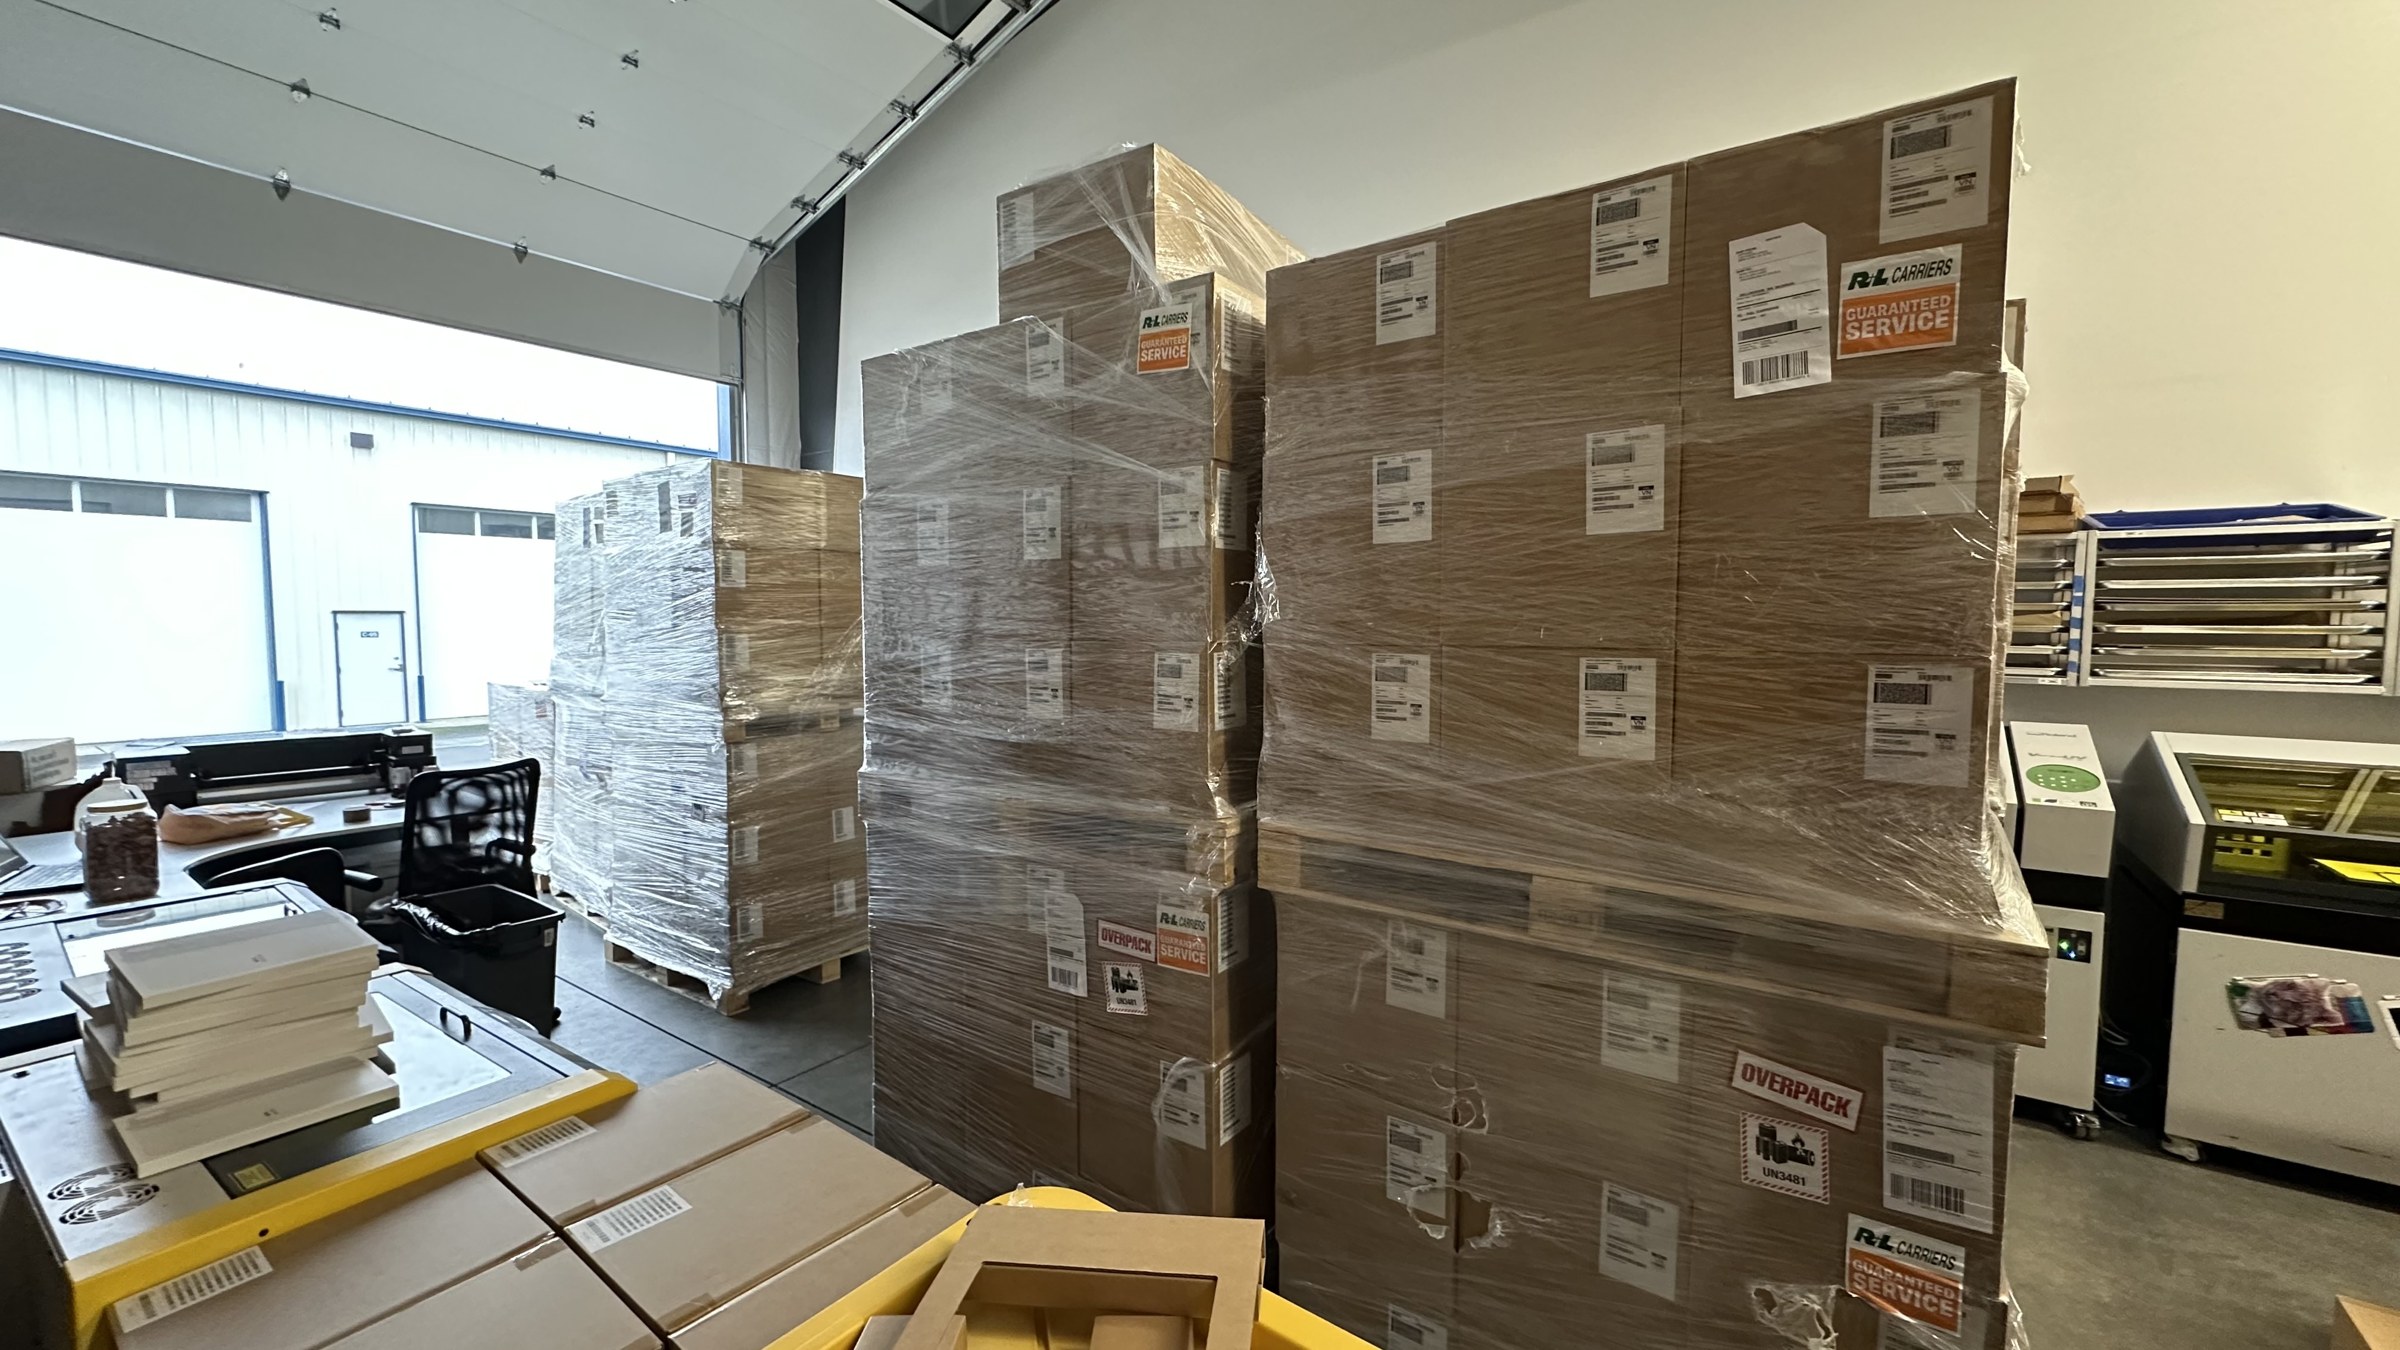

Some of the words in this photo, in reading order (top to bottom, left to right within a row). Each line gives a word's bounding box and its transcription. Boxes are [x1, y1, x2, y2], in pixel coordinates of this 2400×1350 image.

[1848, 268, 1888, 291] R+L
[1891, 258, 1954, 284] CARRIERS
[1161, 311, 1189, 326] CARRIERS
[1846, 294, 1951, 322] GUARANTEED
[1845, 309, 1950, 341] SERVICE
[1140, 345, 1187, 362] SERVICE
[1141, 335, 1187, 350] GUARANTEED
[1178, 916, 1206, 931] CARRIERS
[1101, 926, 1152, 954] OVERPACK
[1160, 945, 1207, 965] SERVICE
[1741, 1062, 1852, 1119] OVERPACK
[1762, 1166, 1806, 1187] UN3481
[1896, 1241, 1957, 1271] CARRIERS
[1852, 1259, 1956, 1299] GUARANTEED
[1851, 1272, 1954, 1318] SERVICE
